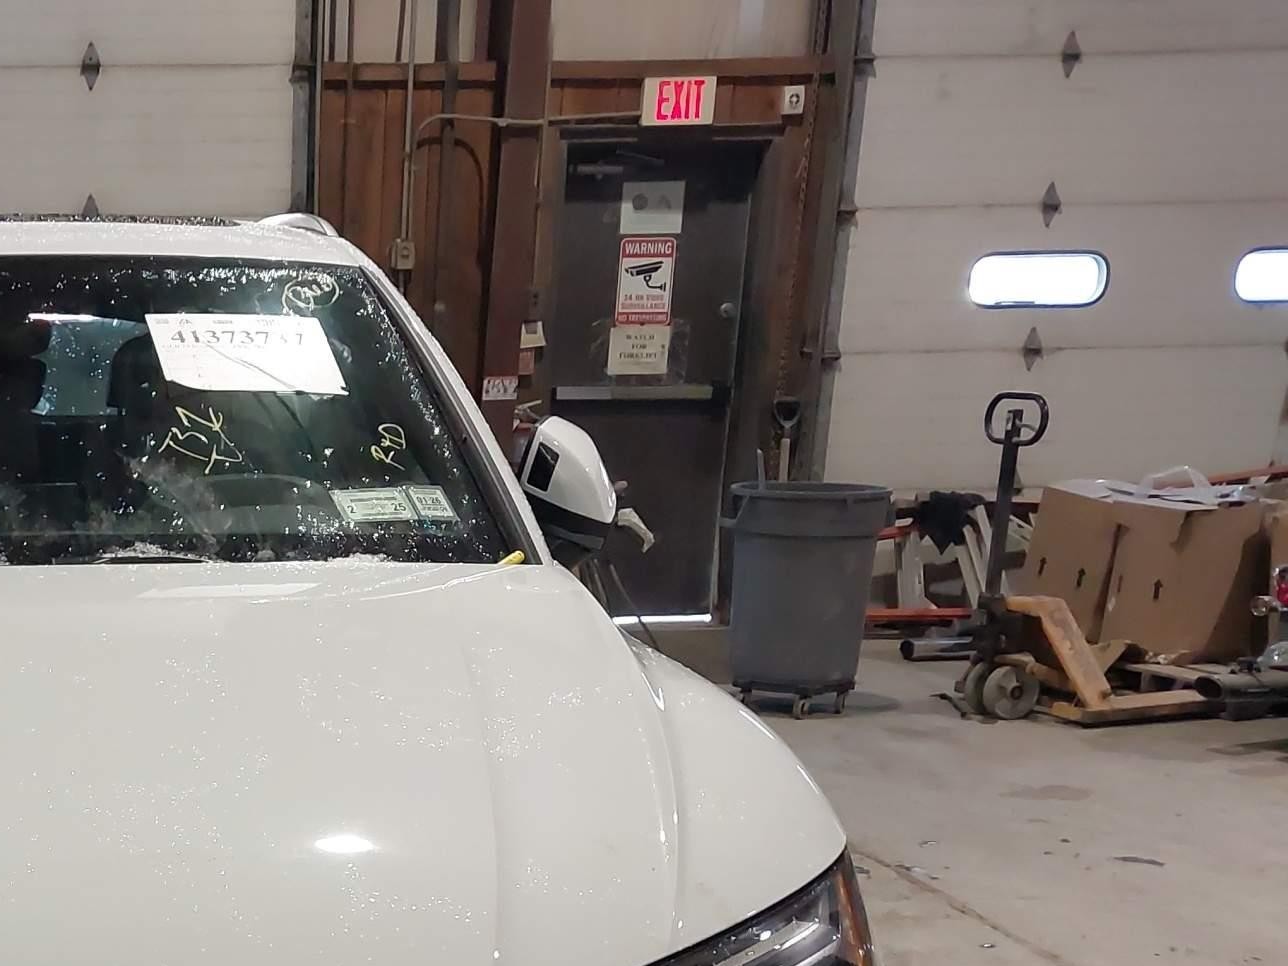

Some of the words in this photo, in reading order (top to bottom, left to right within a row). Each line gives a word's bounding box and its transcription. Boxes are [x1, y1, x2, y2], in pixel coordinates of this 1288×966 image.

[656, 79, 706, 121] EXIT
[625, 242, 672, 255] WARNING
[391, 502, 407, 512] 25
